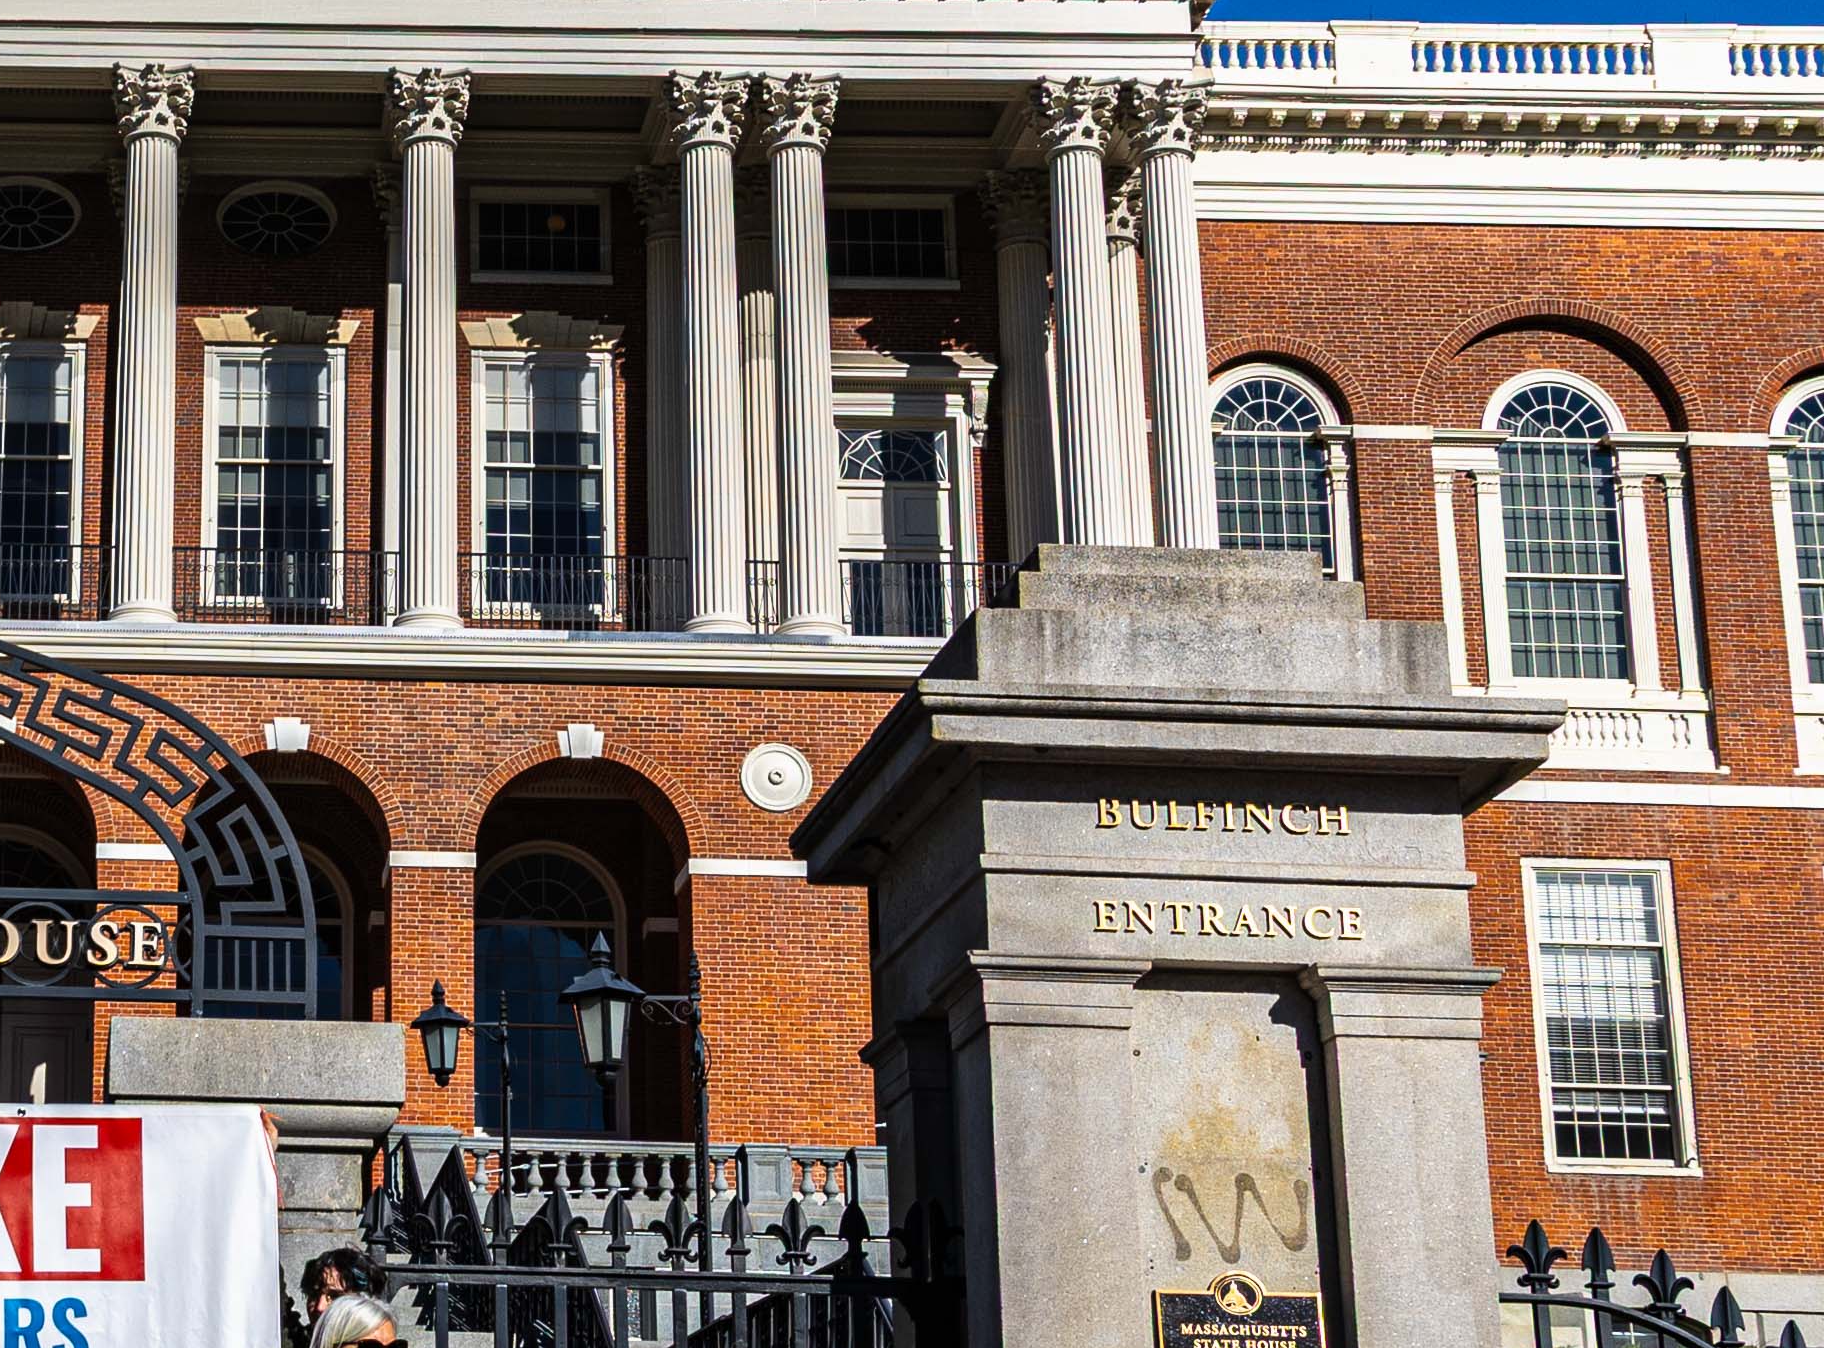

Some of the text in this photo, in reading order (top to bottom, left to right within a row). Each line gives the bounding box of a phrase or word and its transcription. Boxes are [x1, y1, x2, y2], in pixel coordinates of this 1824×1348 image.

[1096, 798, 1352, 835] BULFINCH
[1093, 900, 1366, 940] ENTRANCE
[1180, 1322, 1308, 1338] MASSACHUSETTS
